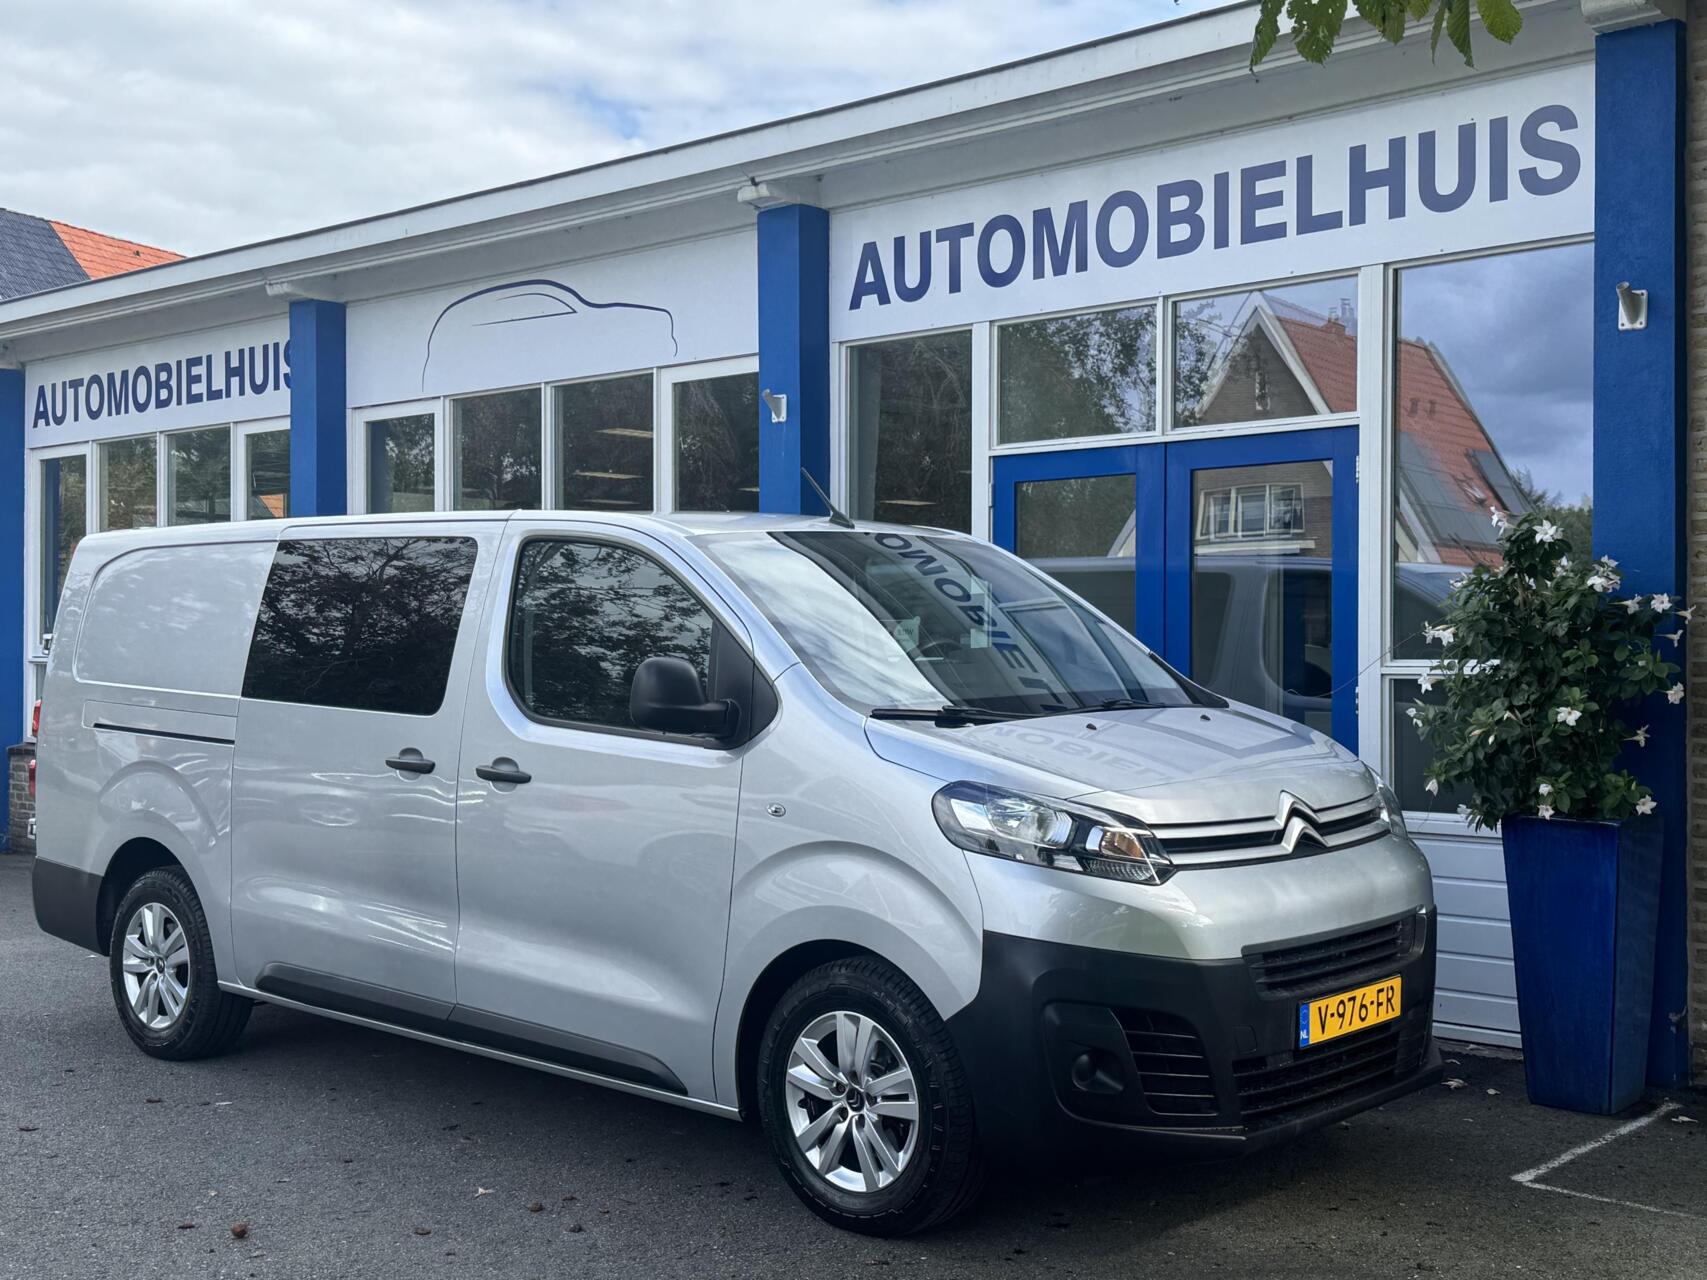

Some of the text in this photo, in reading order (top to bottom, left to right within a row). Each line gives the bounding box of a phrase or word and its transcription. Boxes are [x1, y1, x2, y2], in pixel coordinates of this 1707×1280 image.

[849, 104, 1582, 311] AUTOMOBIELHUIS
[1300, 1029, 1309, 1040] NL
[1318, 984, 1395, 1035] V-976-FR
